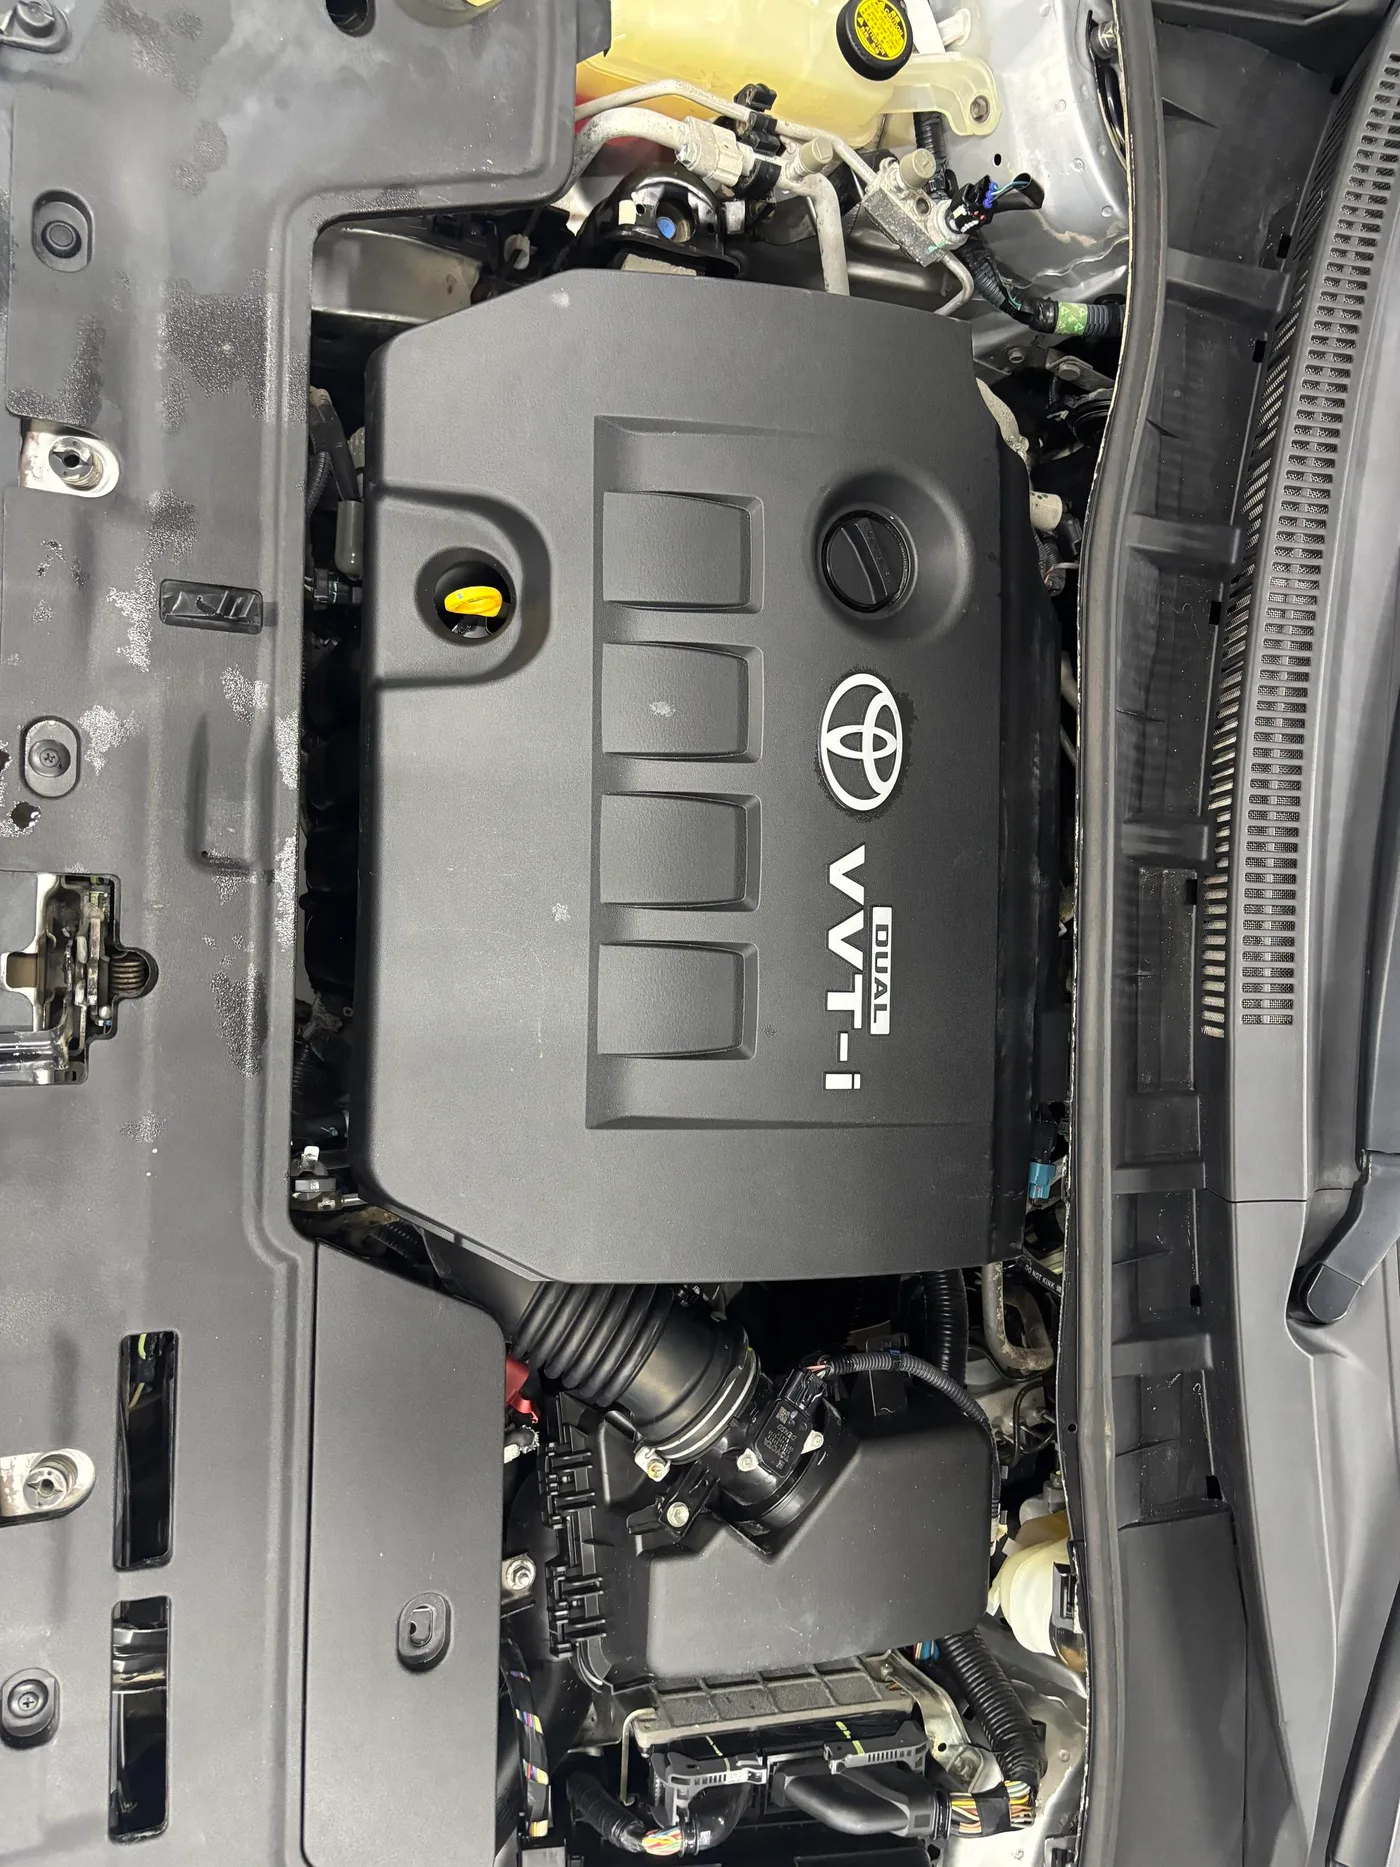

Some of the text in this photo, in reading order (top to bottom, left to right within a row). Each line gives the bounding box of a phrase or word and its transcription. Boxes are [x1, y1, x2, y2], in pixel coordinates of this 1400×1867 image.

[825, 844, 865, 1090] VVT-i
[873, 924, 889, 1024] DUAL
[1032, 1269, 1042, 1281] NOT
[1042, 1277, 1055, 1290] KINK
[777, 1424, 797, 1441] DENSO
[764, 1437, 789, 1463] TOYOTA
